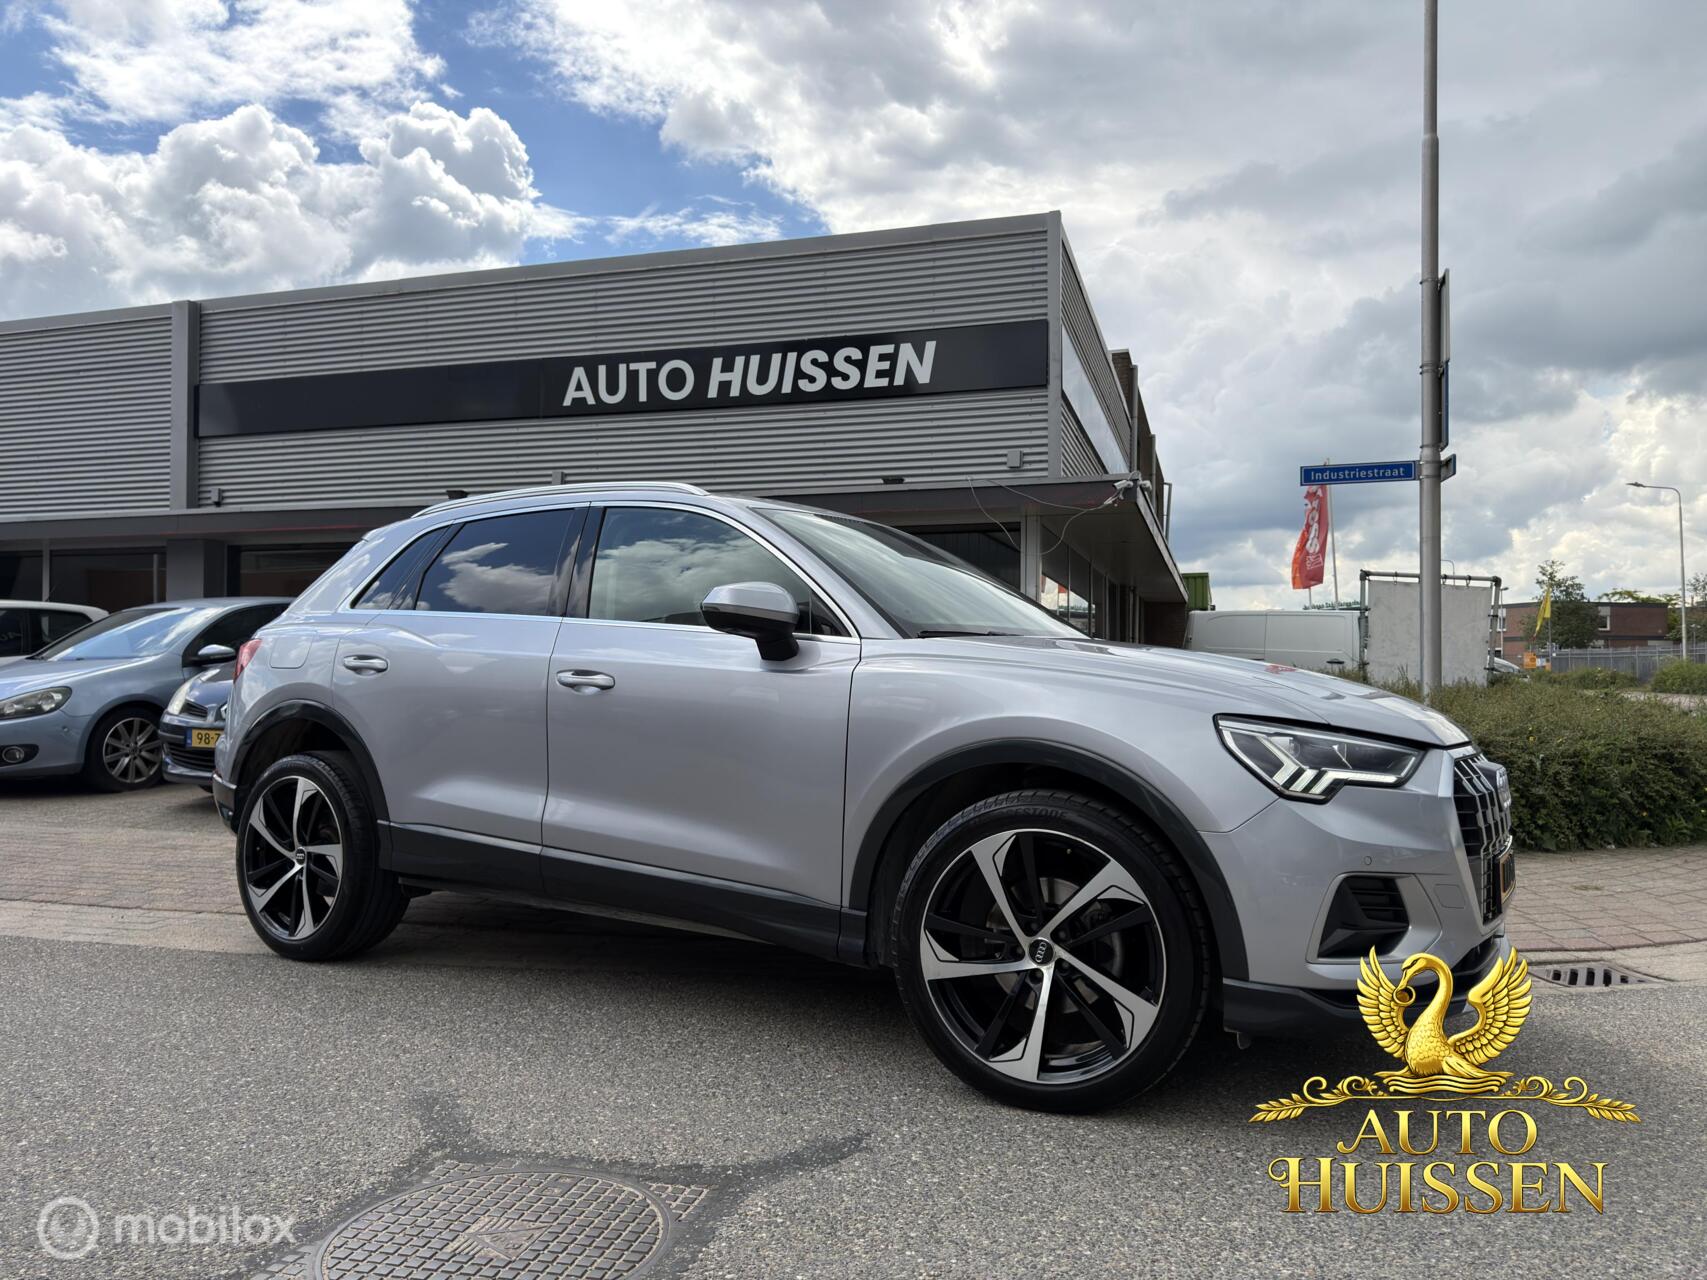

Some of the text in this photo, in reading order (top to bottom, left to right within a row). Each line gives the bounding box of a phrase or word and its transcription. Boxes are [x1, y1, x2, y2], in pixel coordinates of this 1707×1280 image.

[563, 340, 936, 406] AUTO HUISSEN
[1311, 467, 1405, 480] Industriestraat
